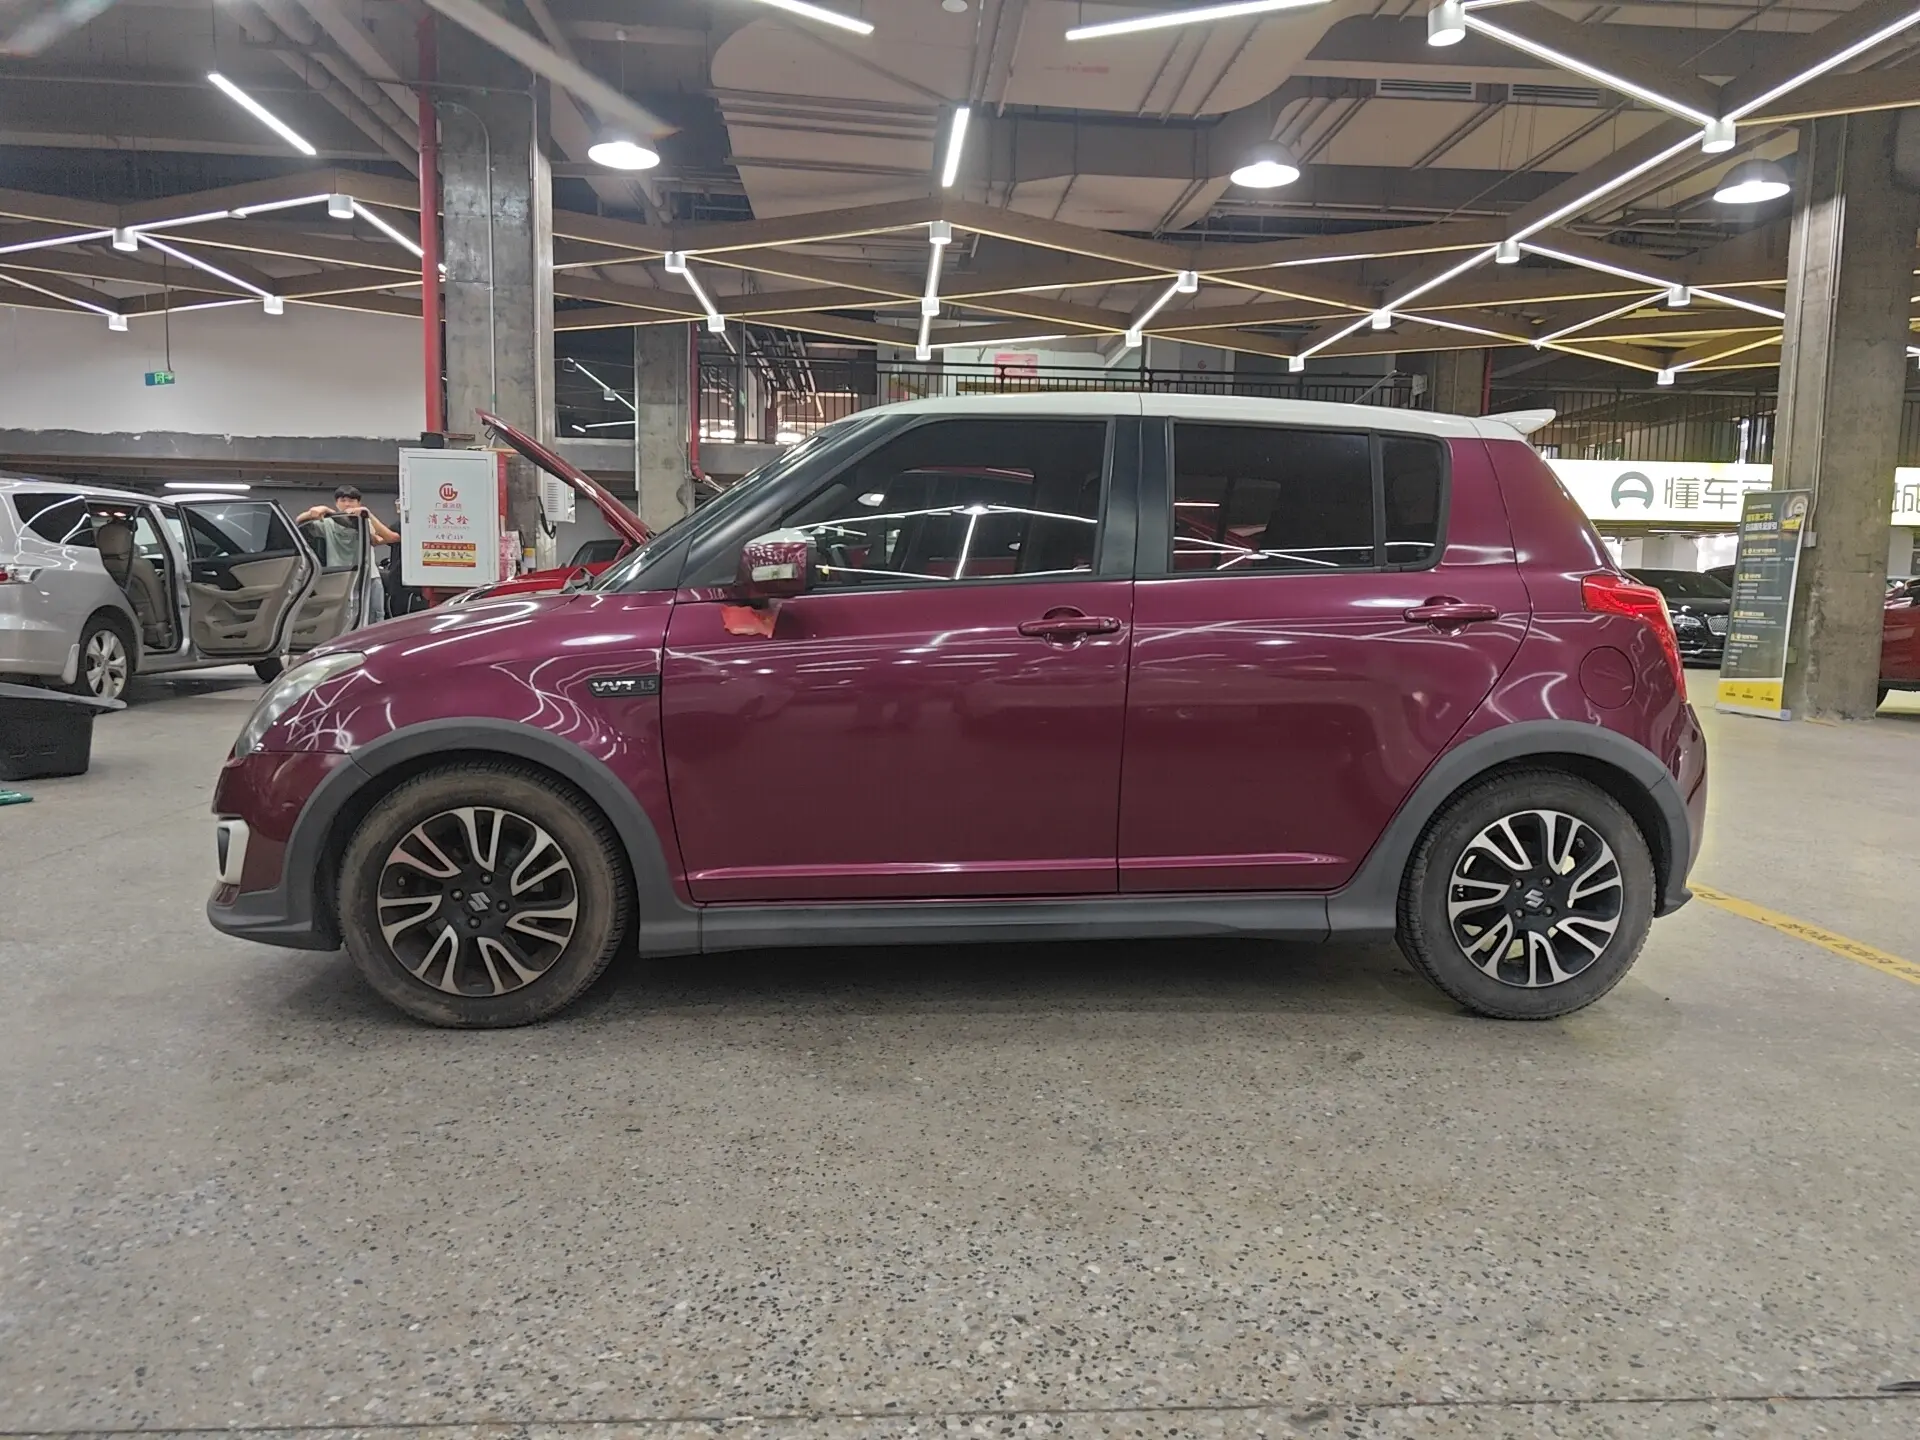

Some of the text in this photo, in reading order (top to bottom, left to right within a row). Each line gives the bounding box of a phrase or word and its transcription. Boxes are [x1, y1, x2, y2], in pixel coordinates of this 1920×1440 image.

[427, 513, 469, 525] 消火栓
[591, 680, 656, 692] VVT 1.5
